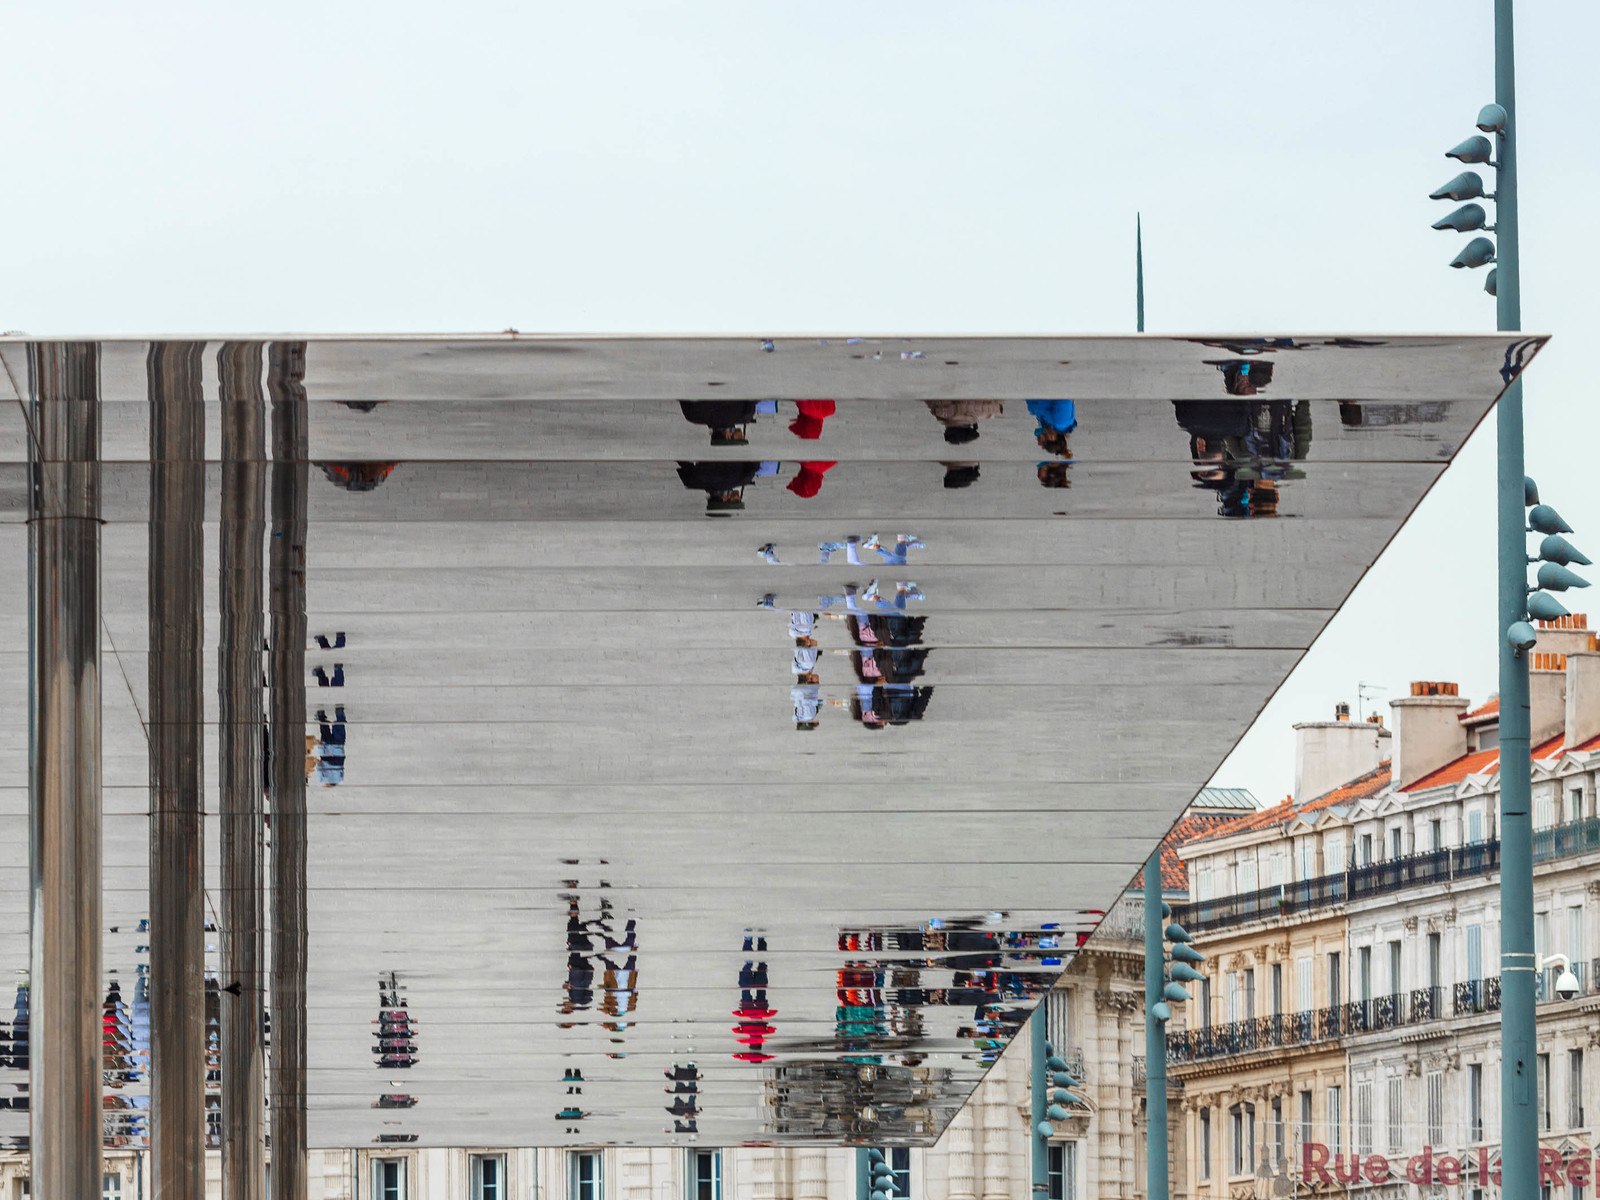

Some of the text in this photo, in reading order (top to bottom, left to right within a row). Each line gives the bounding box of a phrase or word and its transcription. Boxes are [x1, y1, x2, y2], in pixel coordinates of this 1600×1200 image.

[1303, 1142, 1389, 1184] Rue
[1406, 1145, 1461, 1186] de
[1539, 1147, 1600, 1198] Ré
